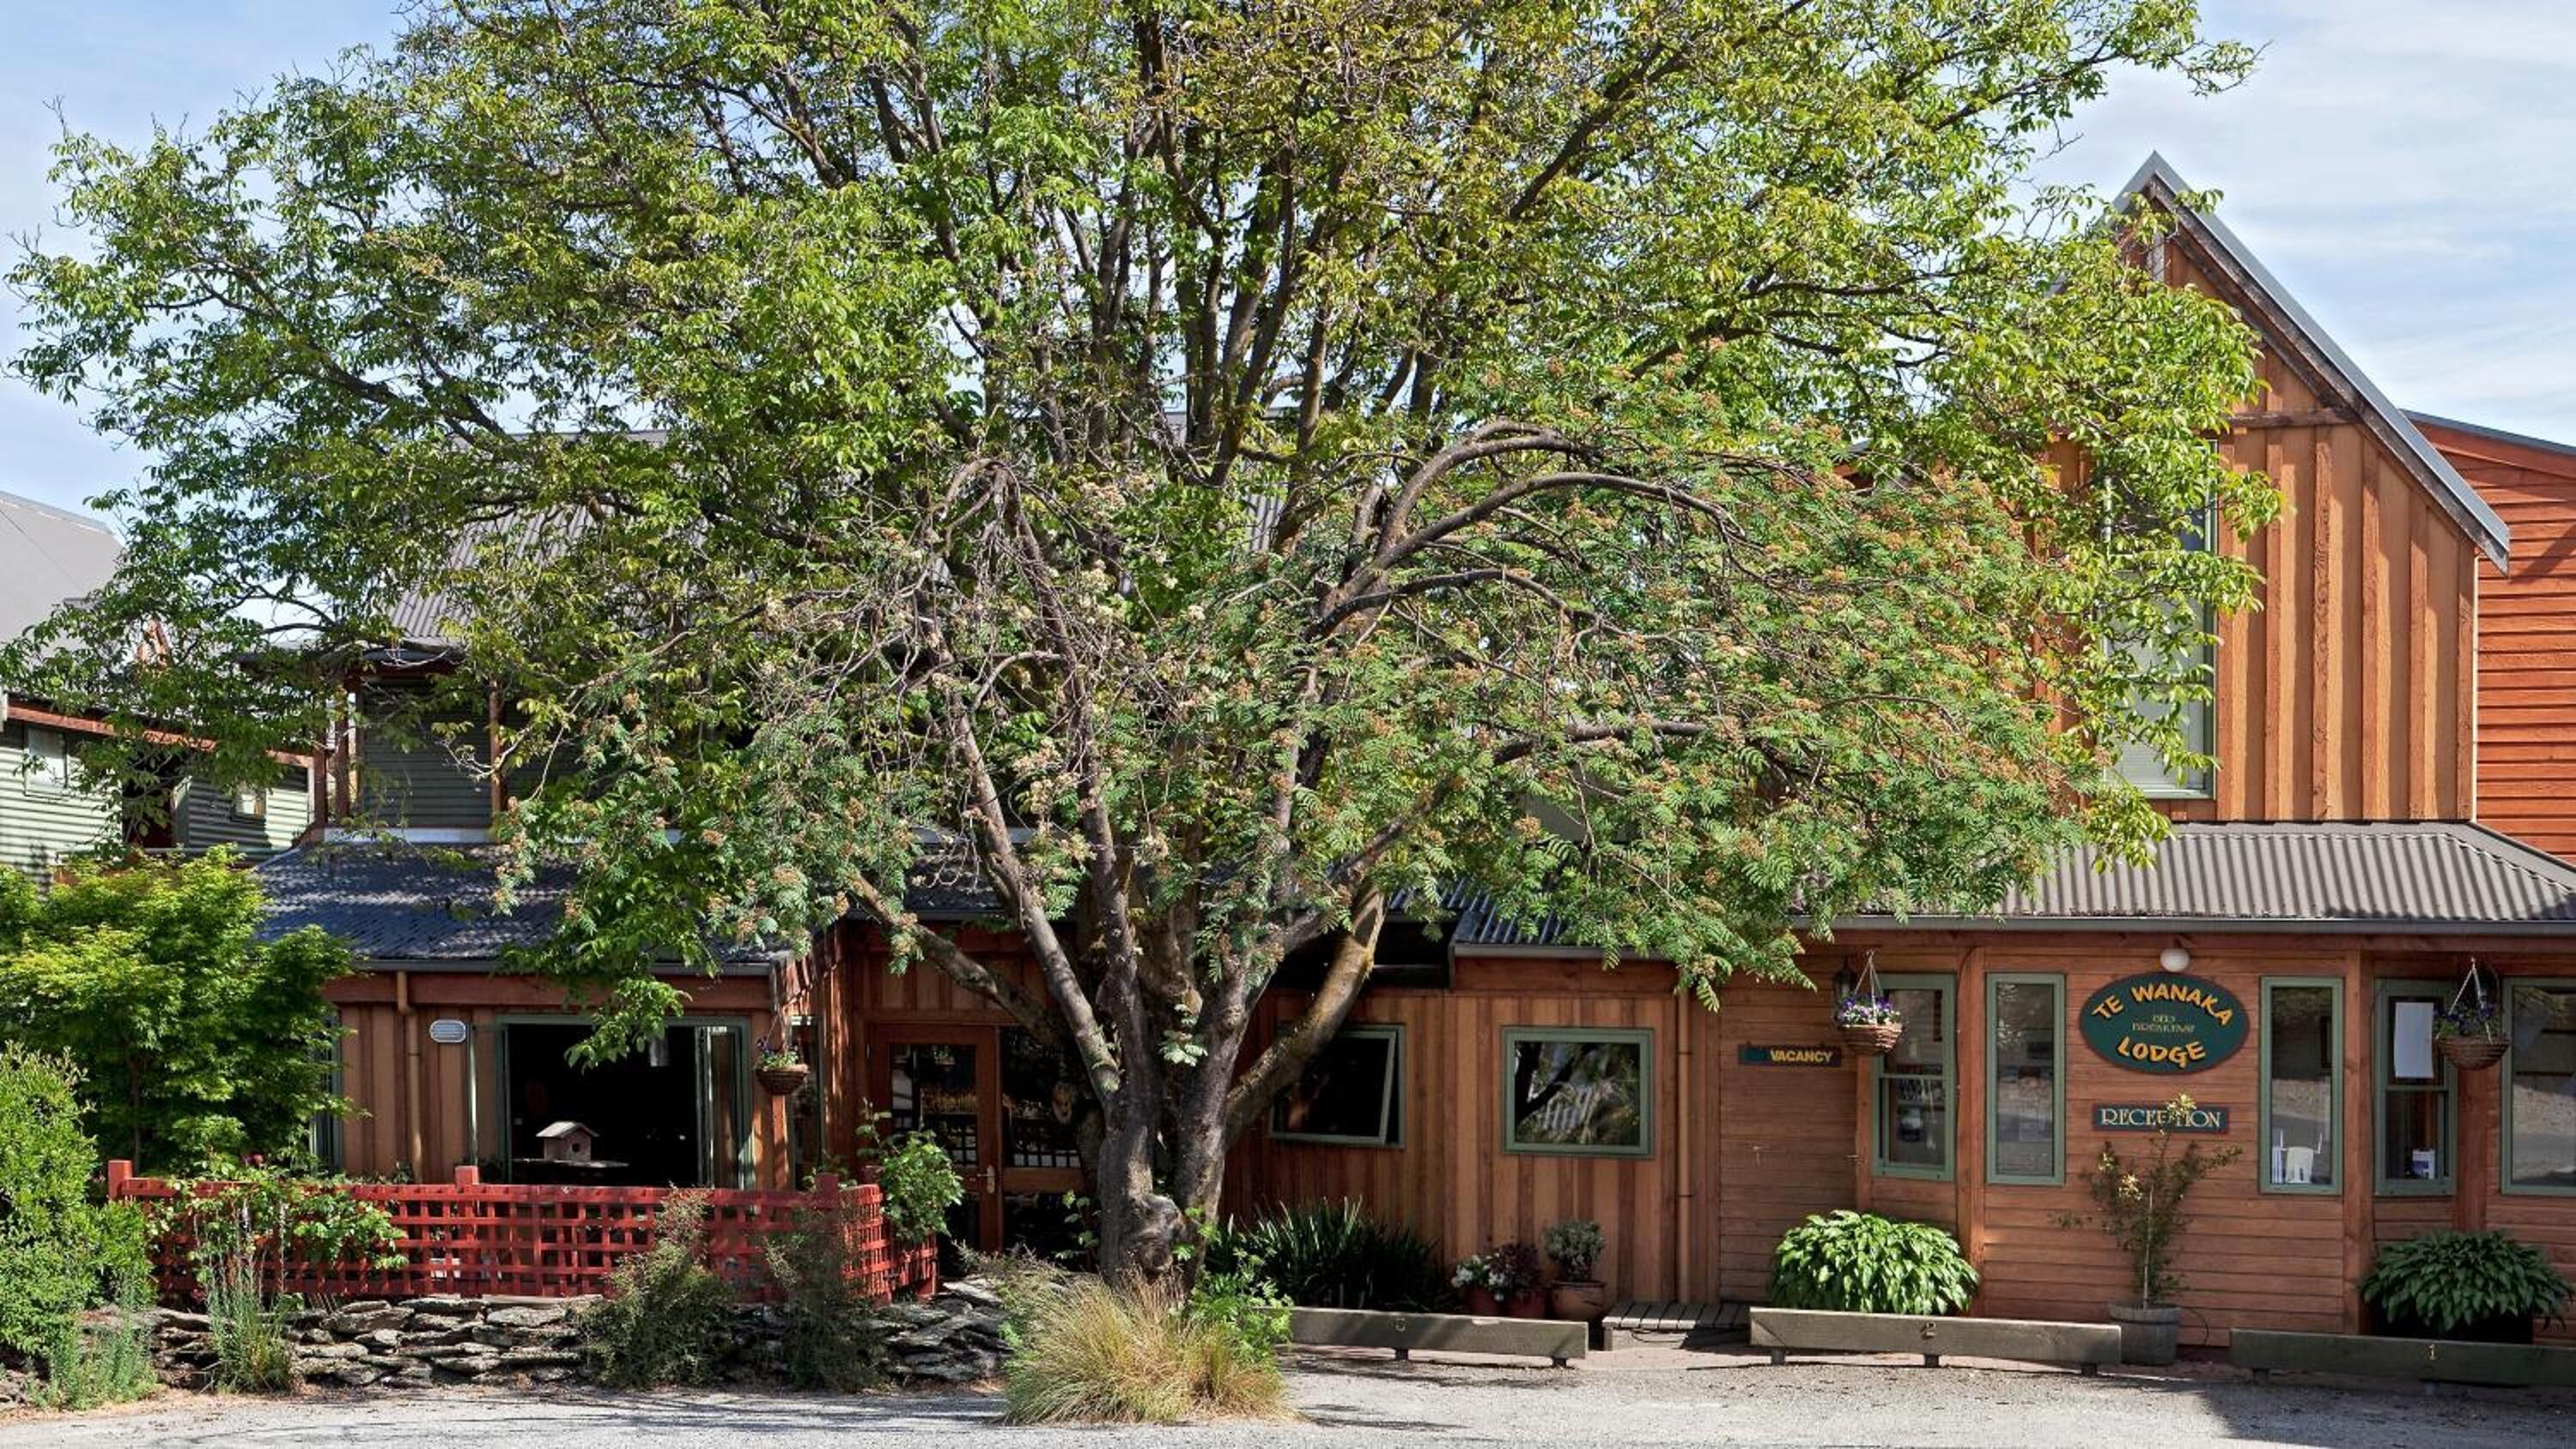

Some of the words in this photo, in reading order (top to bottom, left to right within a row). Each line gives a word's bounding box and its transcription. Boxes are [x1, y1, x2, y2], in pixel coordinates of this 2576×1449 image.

[2091, 995, 2123, 1019] TE
[2130, 984, 2233, 1026] WANAKA
[1770, 1049, 1832, 1062] VACANCY
[2117, 1036, 2206, 1069] LODGE
[1924, 1322, 1937, 1337] 2
